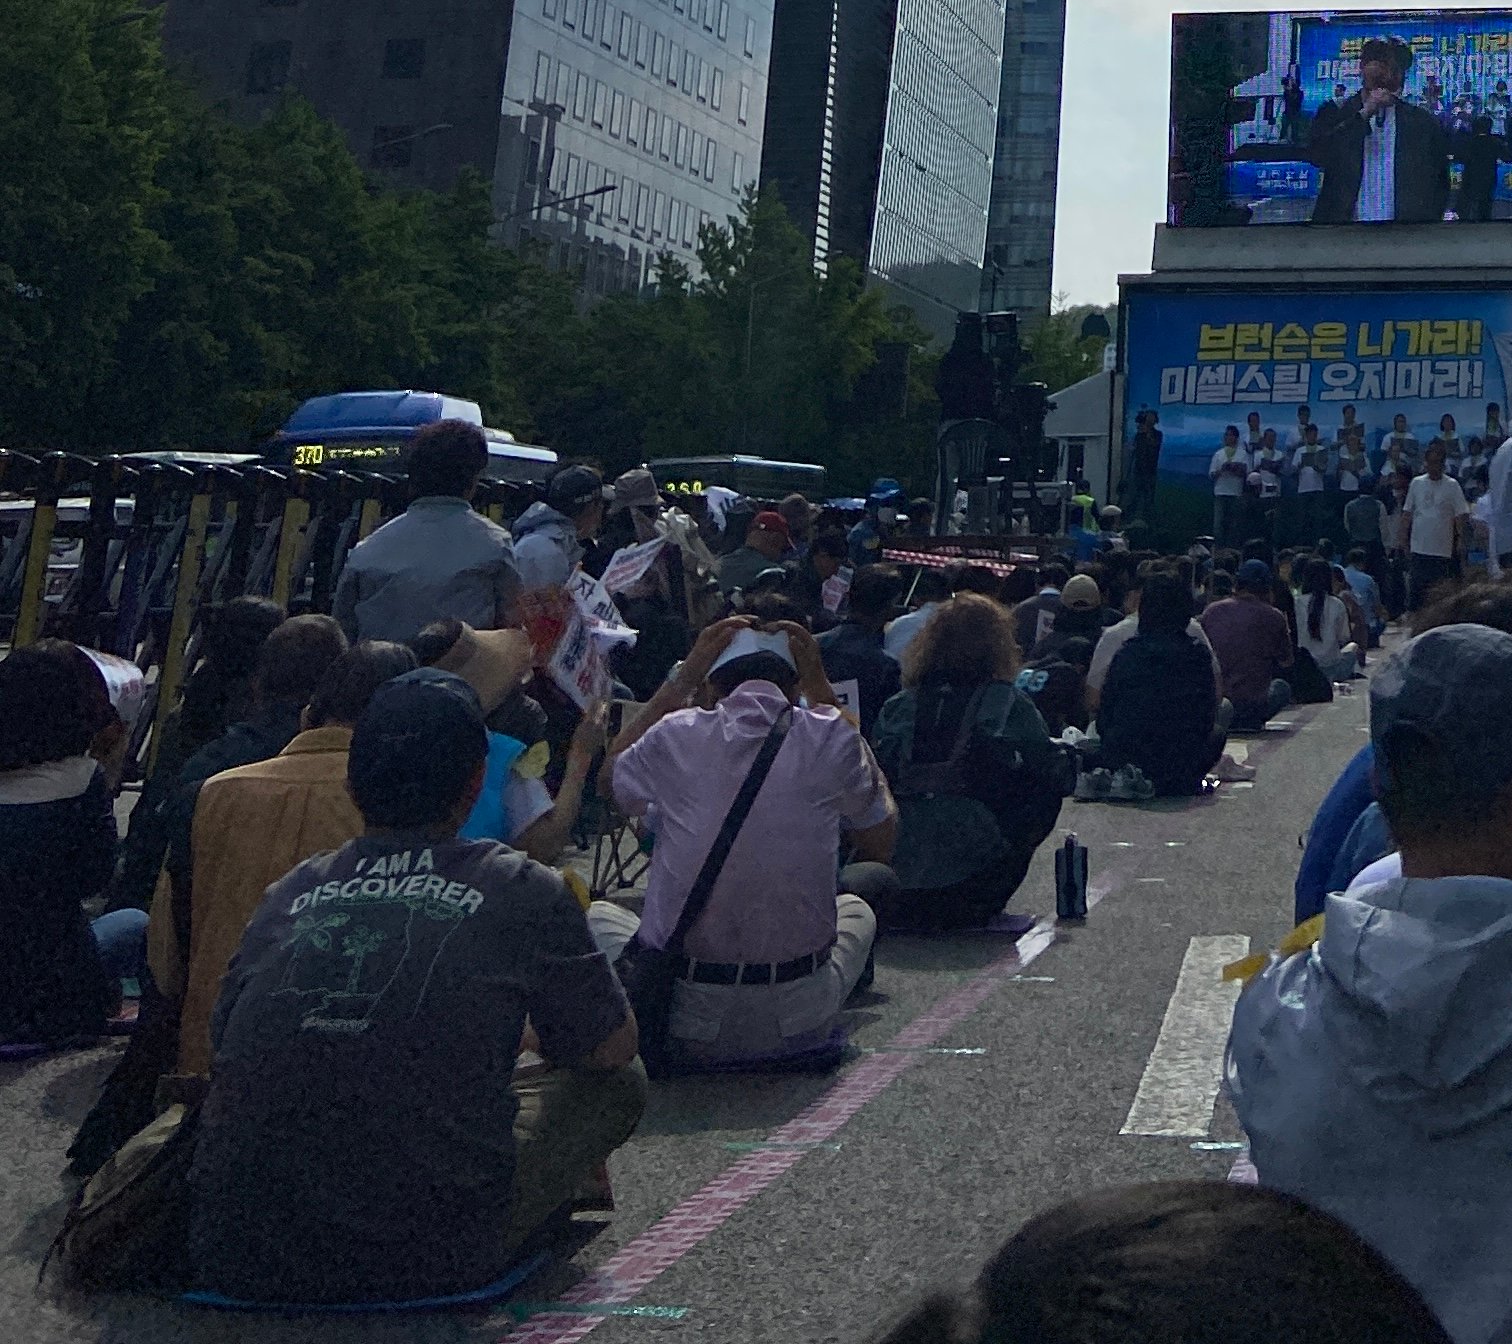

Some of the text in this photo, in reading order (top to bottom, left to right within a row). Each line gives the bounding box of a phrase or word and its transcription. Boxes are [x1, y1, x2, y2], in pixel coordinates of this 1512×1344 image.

[1196, 319, 1483, 363] 브런슨은 나가라!
[1317, 359, 1485, 403] 오지마라!
[294, 444, 323, 465] 370
[355, 848, 435, 877] I AM A
[289, 874, 486, 916] DISCOVERER
